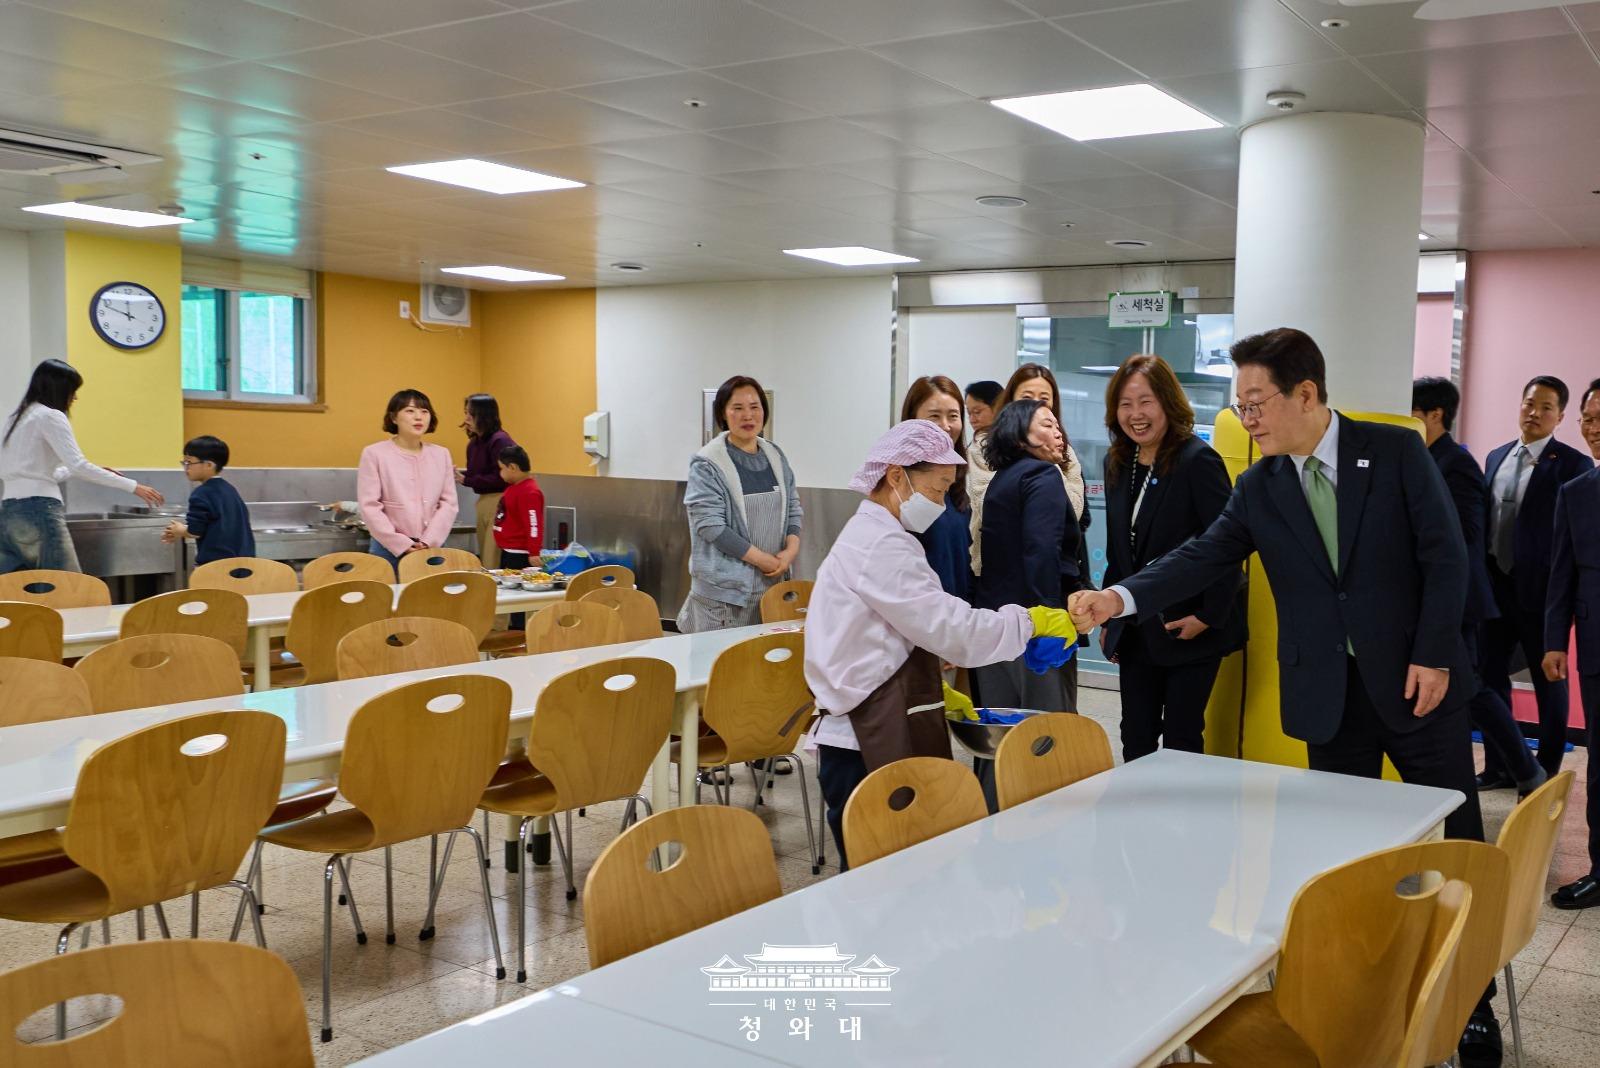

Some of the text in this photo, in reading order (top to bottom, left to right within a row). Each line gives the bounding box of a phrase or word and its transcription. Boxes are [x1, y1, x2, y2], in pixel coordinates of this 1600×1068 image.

[147, 302, 154, 310] 2
[1132, 298, 1164, 312] 세척실
[99, 309, 105, 317] 9
[152, 314, 158, 322] 3
[103, 321, 109, 330] 8
[126, 335, 133, 343] 6
[139, 333, 145, 341] 5
